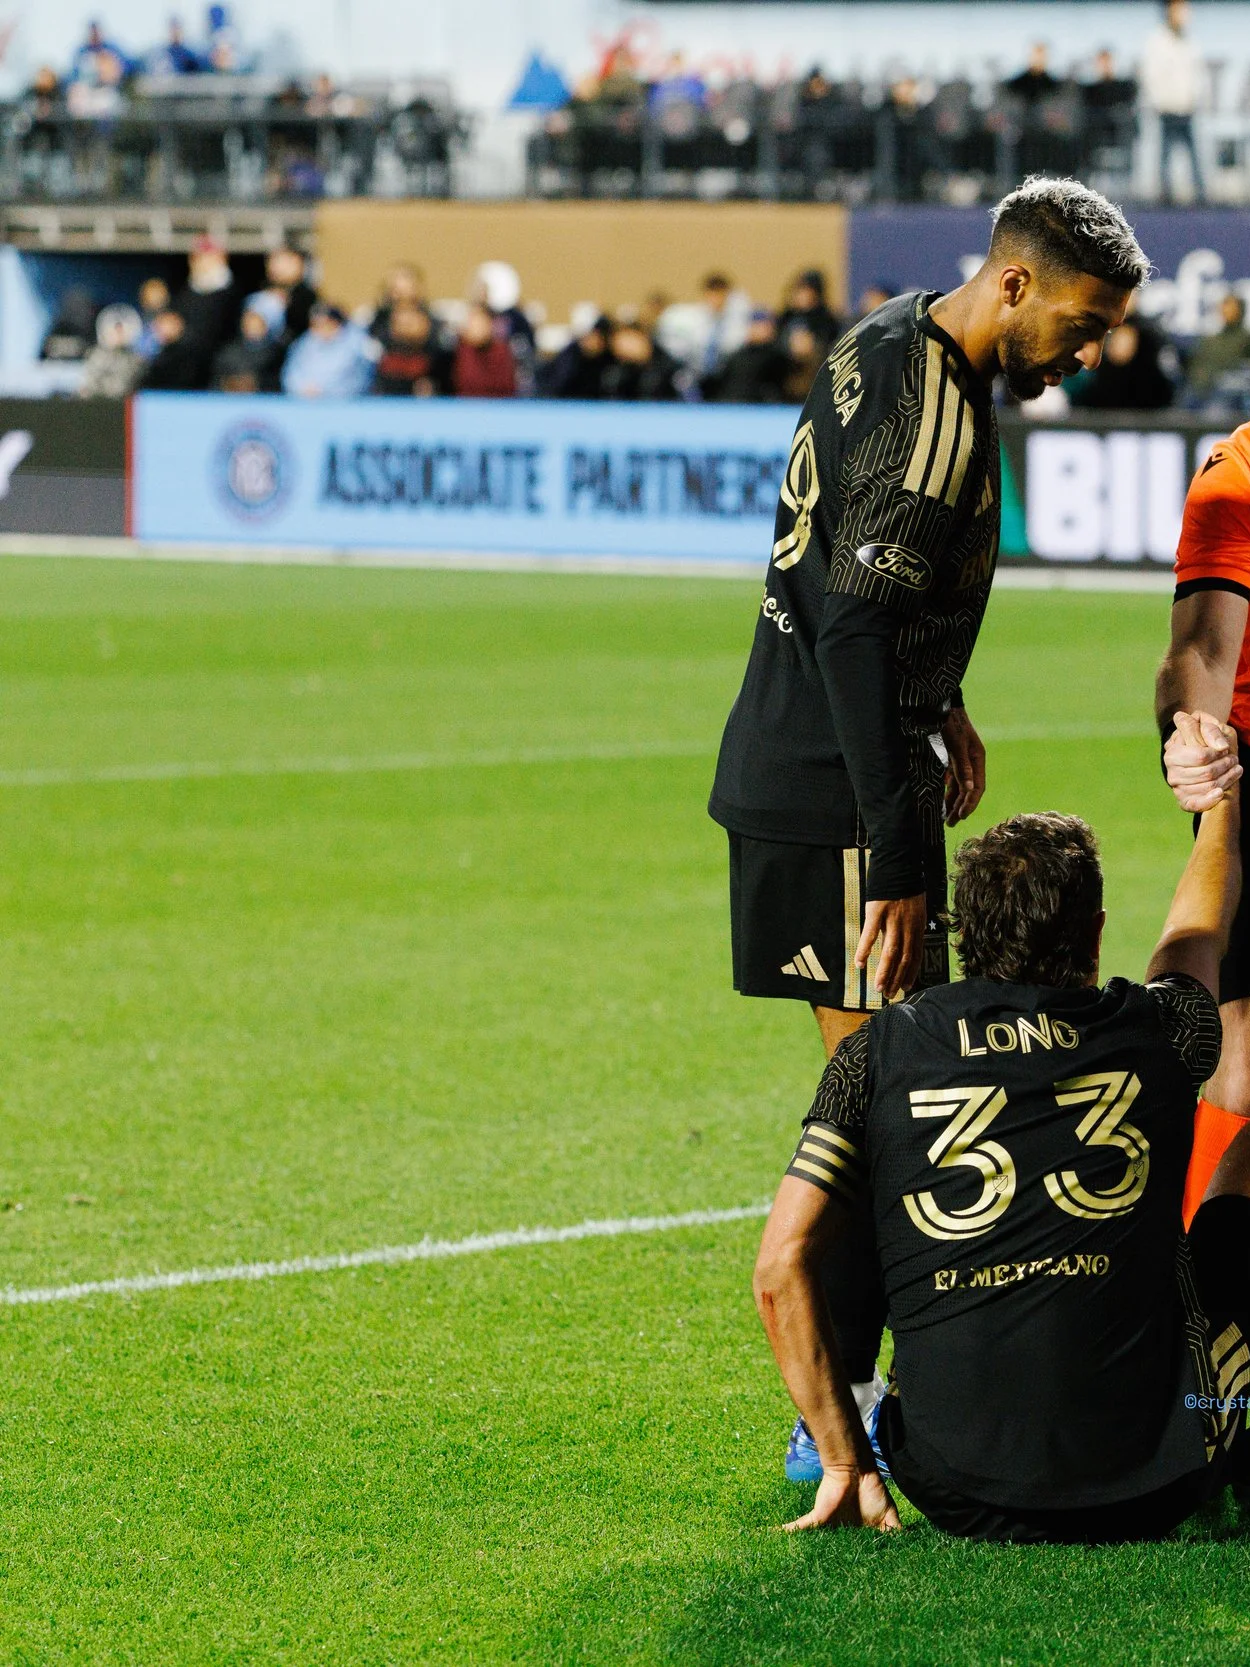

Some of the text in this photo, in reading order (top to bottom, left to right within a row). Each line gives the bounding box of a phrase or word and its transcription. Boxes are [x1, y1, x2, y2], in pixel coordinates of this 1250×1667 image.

[828, 324, 864, 427] UANGA
[321, 441, 541, 514] ASSOCIATE
[874, 548, 926, 585] Ford
[957, 1013, 1080, 1057] LONG
[902, 1071, 1151, 1241] 33
[934, 1254, 1110, 1291] EL MEXICANO
